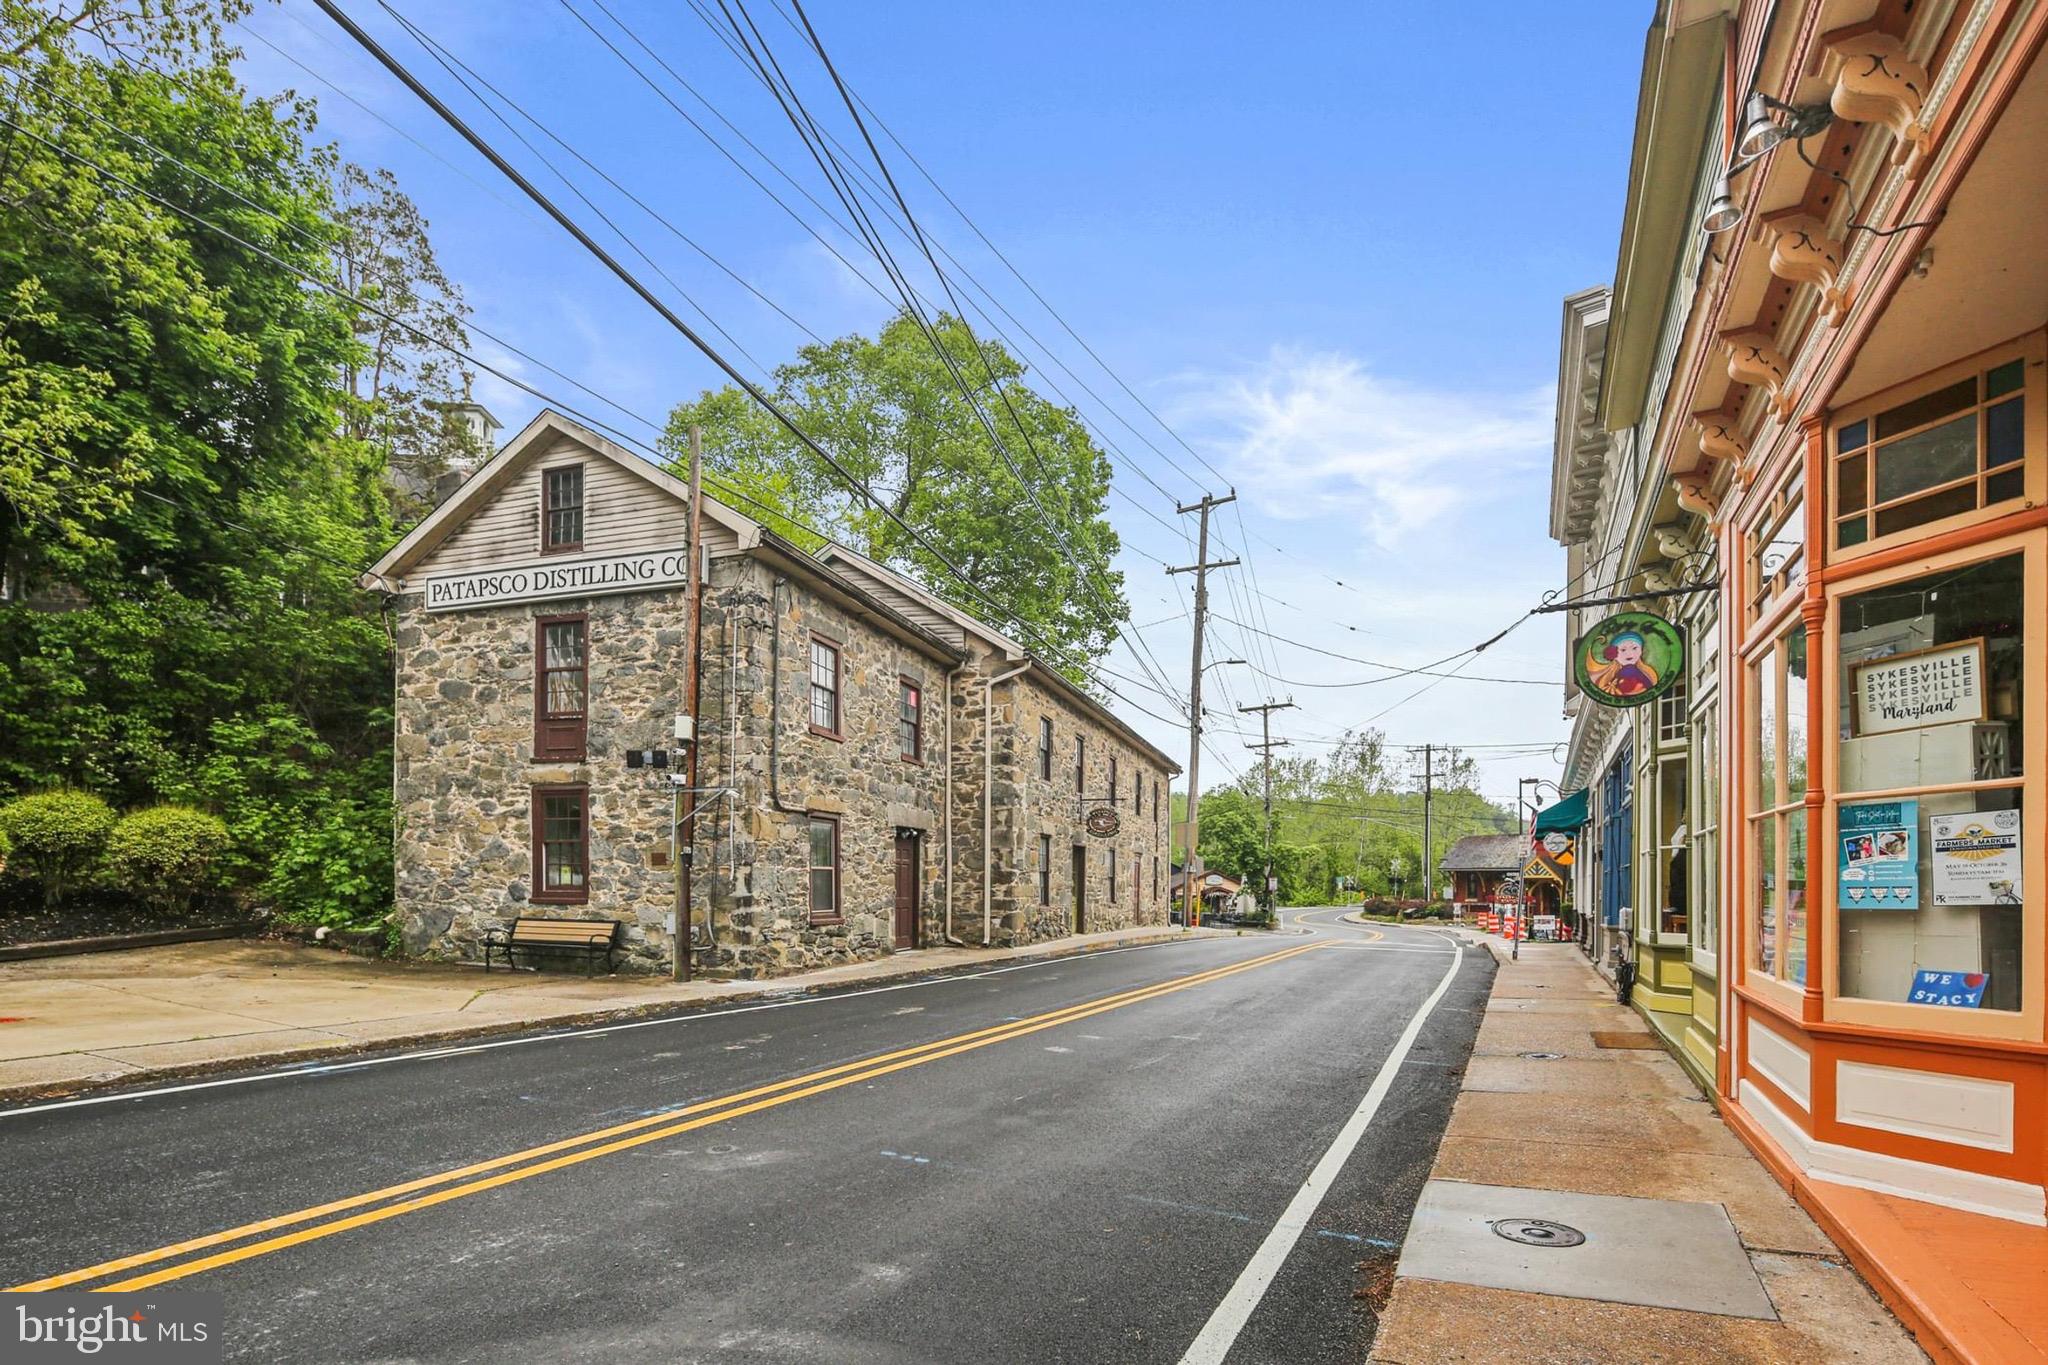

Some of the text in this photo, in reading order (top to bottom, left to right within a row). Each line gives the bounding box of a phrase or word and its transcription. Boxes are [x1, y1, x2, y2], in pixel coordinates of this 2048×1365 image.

[431, 574, 527, 602] PATAPSCO
[534, 559, 656, 591] DISTILLING
[1867, 655, 1971, 683] SYKESVILLE
[1867, 666, 1972, 693] SYKESVILLE
[1868, 677, 1972, 703] SYKESVILLE
[1868, 687, 1973, 713] SYKESVILLE
[1882, 697, 1958, 720] Maryland
[1936, 839, 1974, 848] FARMERS
[1977, 837, 2012, 845] MARKET
[1924, 973, 1952, 985] WE
[1914, 990, 1977, 1005] STACY
